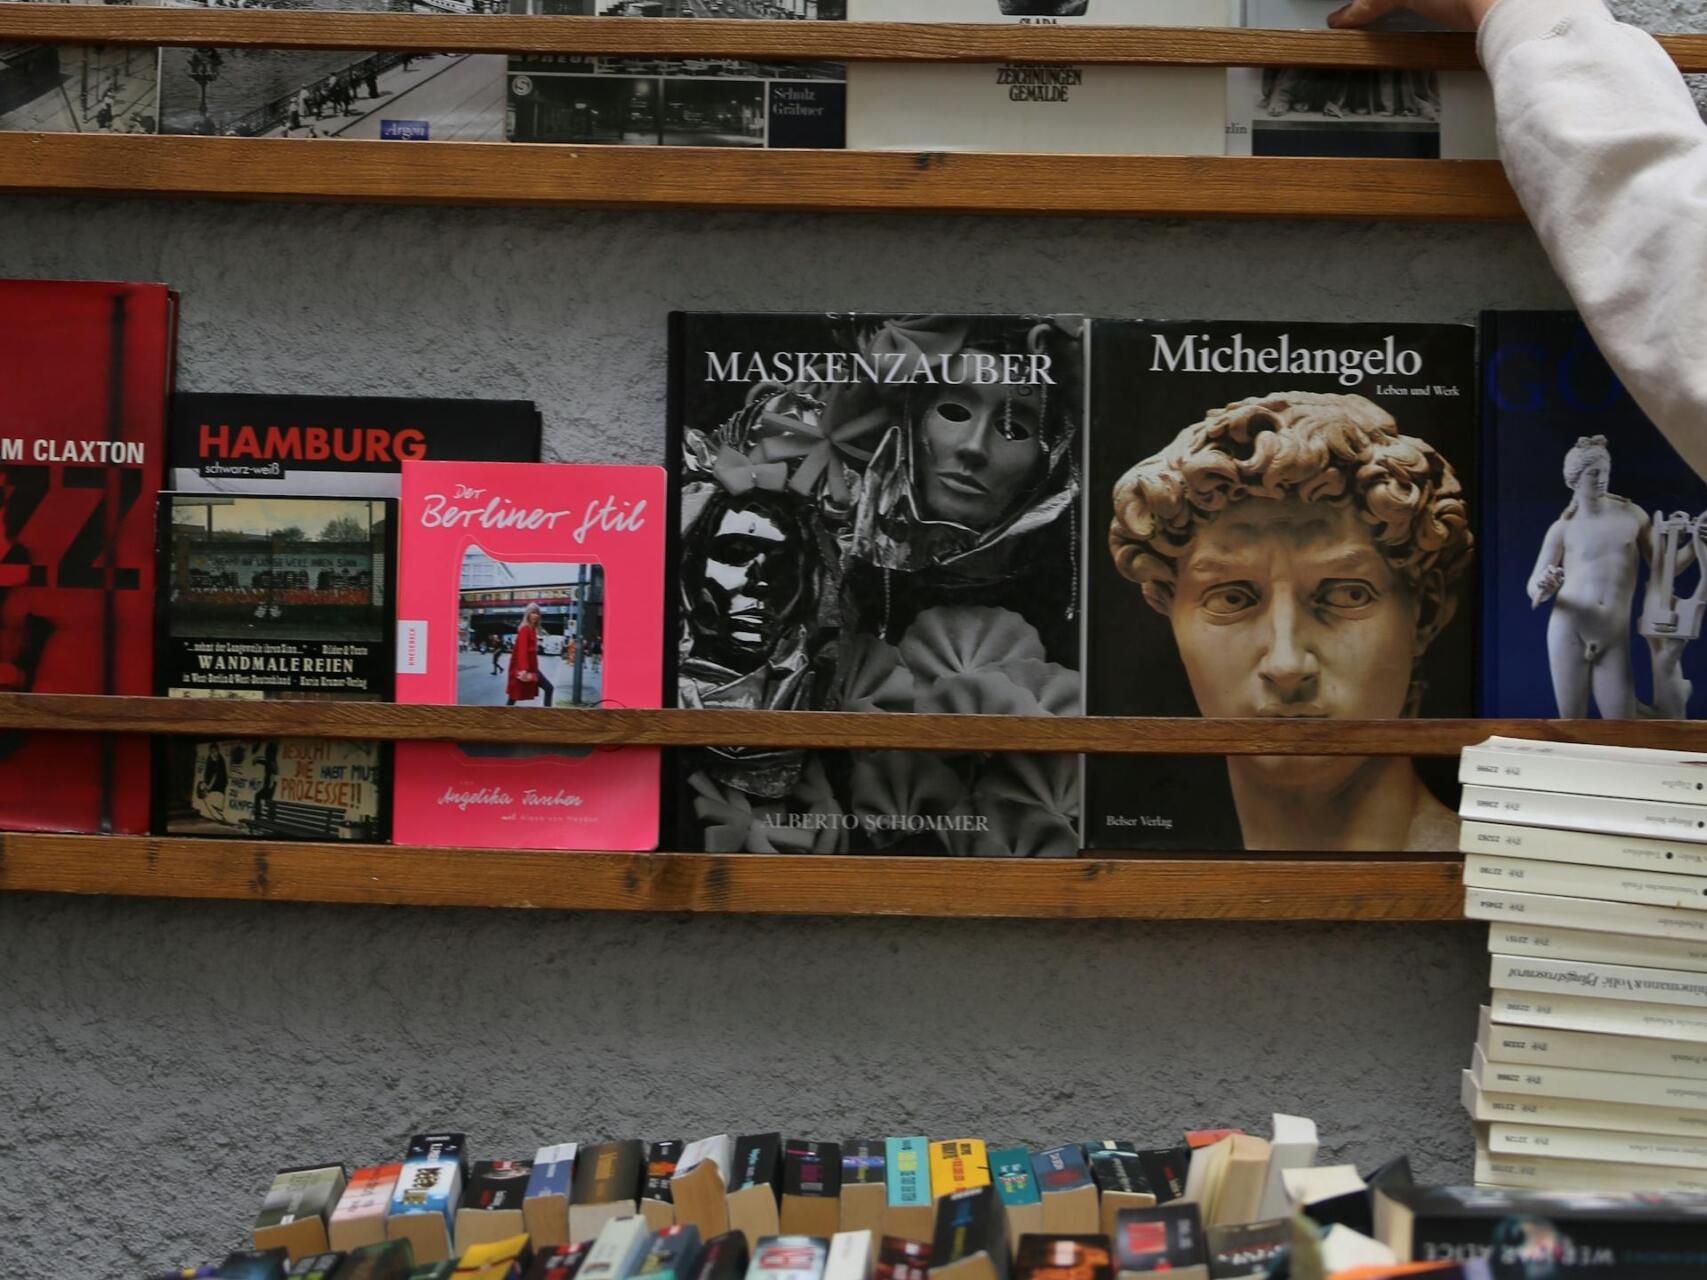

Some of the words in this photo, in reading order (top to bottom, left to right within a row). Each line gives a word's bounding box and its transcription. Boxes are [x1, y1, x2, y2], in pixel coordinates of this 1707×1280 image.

[996, 67, 1083, 87] ZEICHNUNGEN
[773, 87, 816, 103] Schulz
[1008, 85, 1069, 103] GEMÄLDE
[772, 102, 825, 119] Gräbner
[384, 122, 426, 140] Argon
[705, 349, 1057, 387] MASKENZAUBER
[1148, 332, 1423, 386] Michelangelo
[1375, 383, 1414, 397] Leben
[1416, 385, 1435, 398] und
[1437, 385, 1460, 398] Werk
[33, 439, 145, 464] CLAXTON
[200, 425, 427, 463] HAMBURG
[204, 462, 280, 477] schwarz-weiß
[453, 483, 487, 500] Der
[421, 494, 570, 532] Berliner
[571, 495, 647, 544] Stil
[198, 655, 355, 673] WANDMALEREIEN
[281, 777, 363, 809] PROZESSE!!
[437, 784, 513, 813] Angelika
[523, 788, 584, 808] Taschen
[760, 812, 859, 832] ALBERTO
[864, 813, 989, 834] SCHOMMER
[1105, 814, 1144, 829] Belser
[1148, 815, 1173, 832] Verlag
